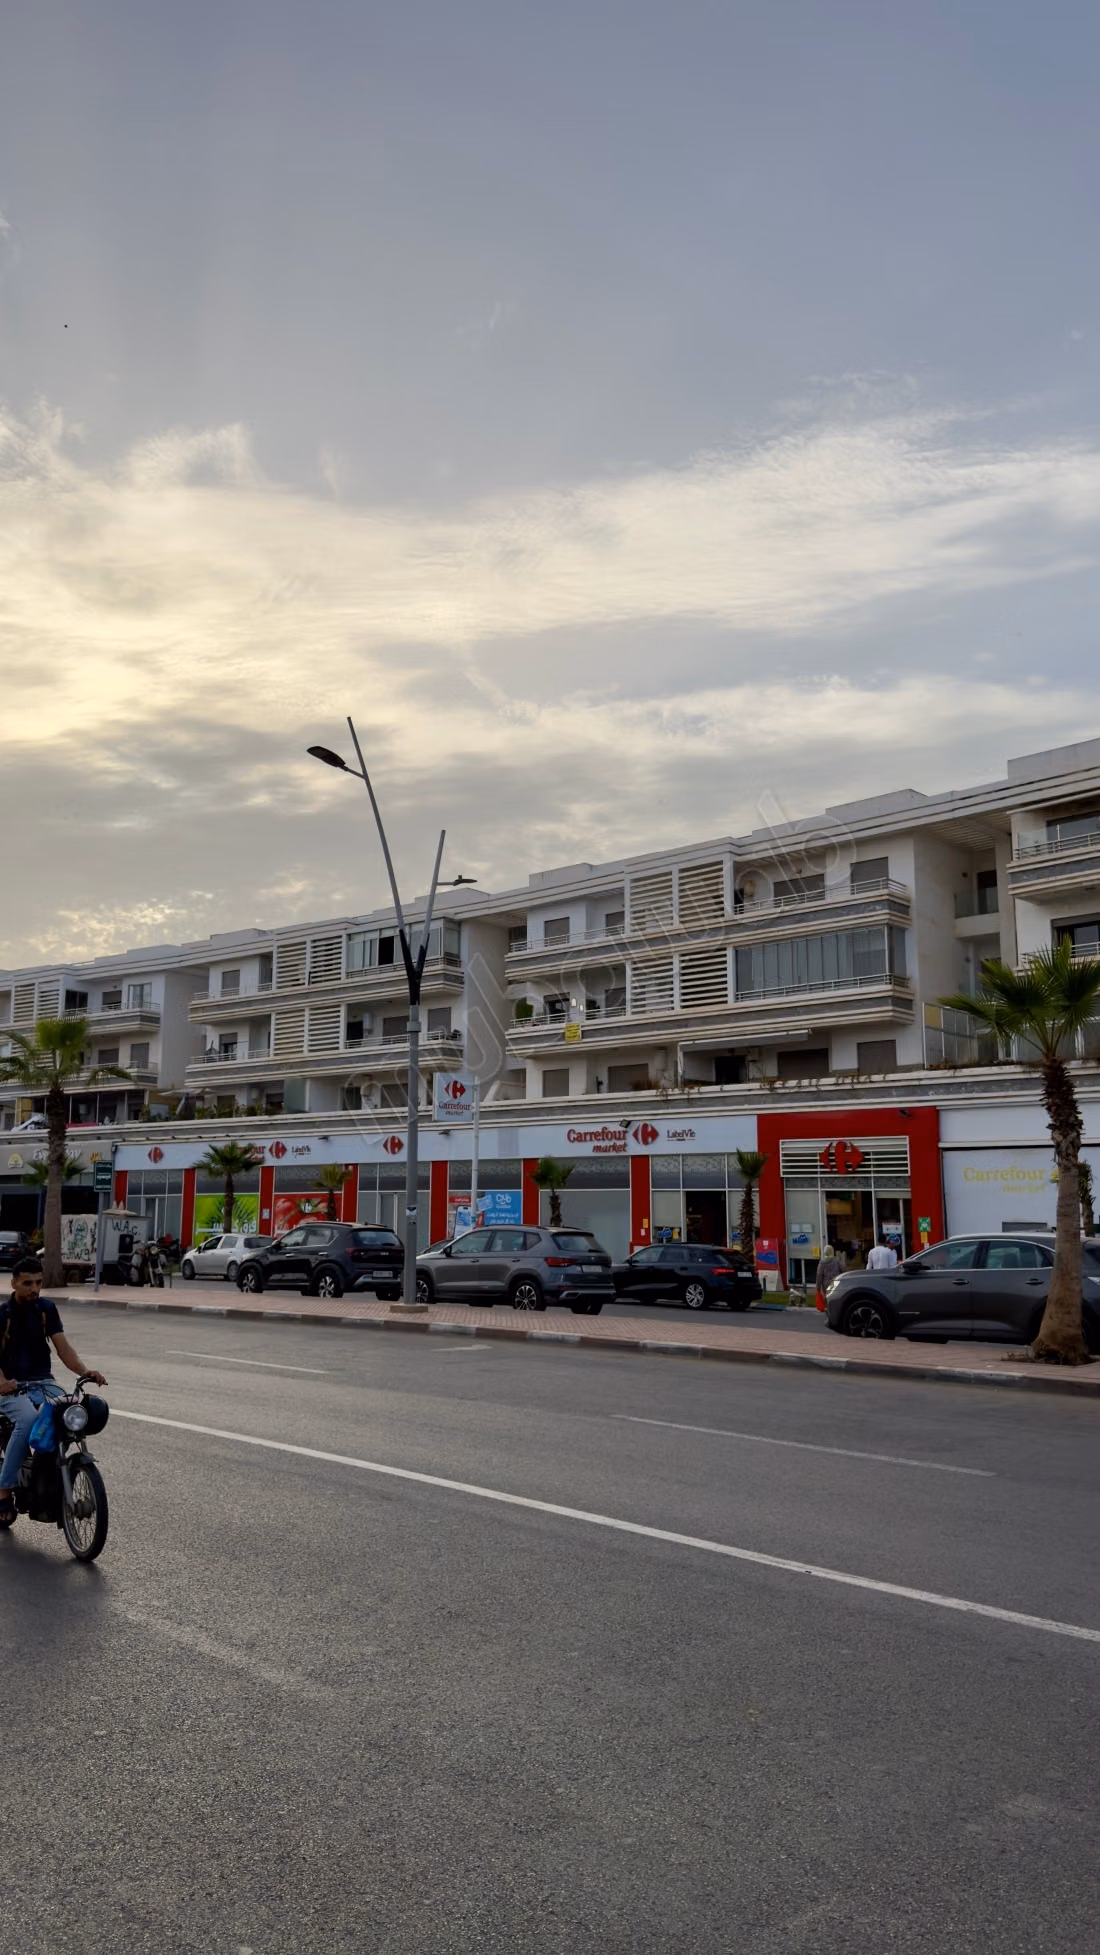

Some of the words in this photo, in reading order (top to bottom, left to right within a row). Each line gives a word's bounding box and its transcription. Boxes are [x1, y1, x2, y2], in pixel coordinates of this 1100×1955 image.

[438, 1100, 471, 1111] Carrefour
[566, 1126, 628, 1143] Carrefour
[666, 1129, 696, 1139] LabelVie
[592, 1141, 628, 1153] market
[962, 1163, 1046, 1183] Carrefour
